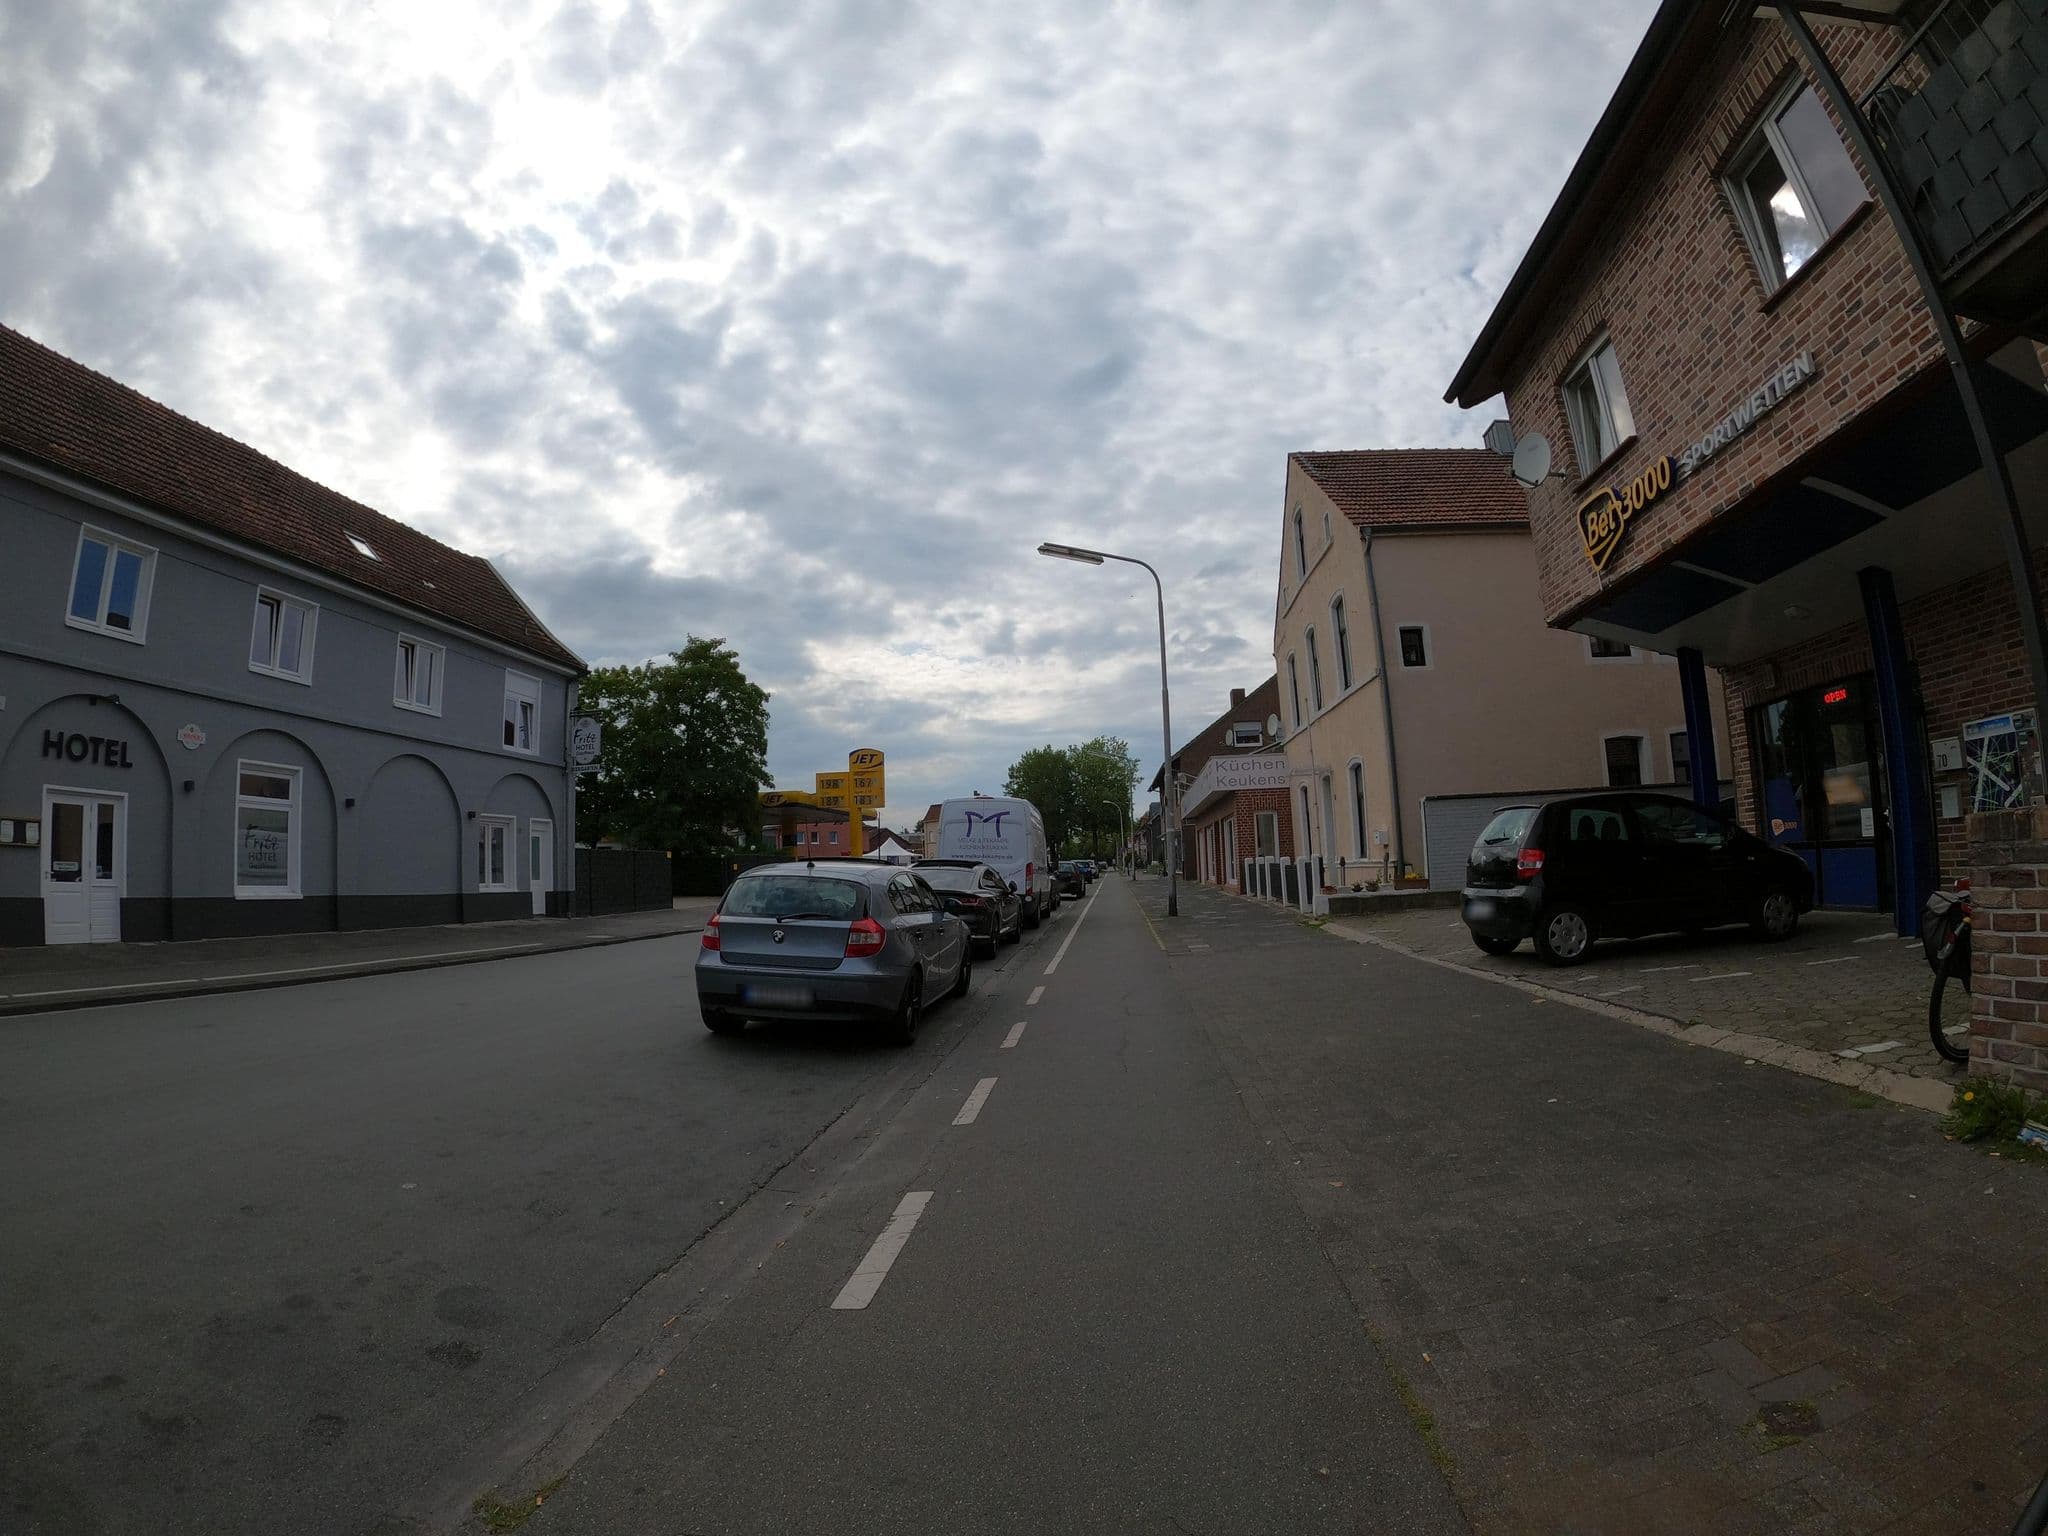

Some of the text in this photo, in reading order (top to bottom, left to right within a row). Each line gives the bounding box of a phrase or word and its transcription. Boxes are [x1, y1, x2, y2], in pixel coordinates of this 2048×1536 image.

[1679, 351, 1816, 477] SPORTWETTEN
[1824, 688, 1847, 703] OPEN
[42, 729, 133, 768] HOTEL
[852, 753, 878, 764] JET
[1936, 754, 1948, 769] 70
[1215, 759, 1286, 773] Küchen
[1216, 775, 1286, 787] Keukens
[765, 794, 784, 803] JET
[248, 851, 278, 862] HOTEL
